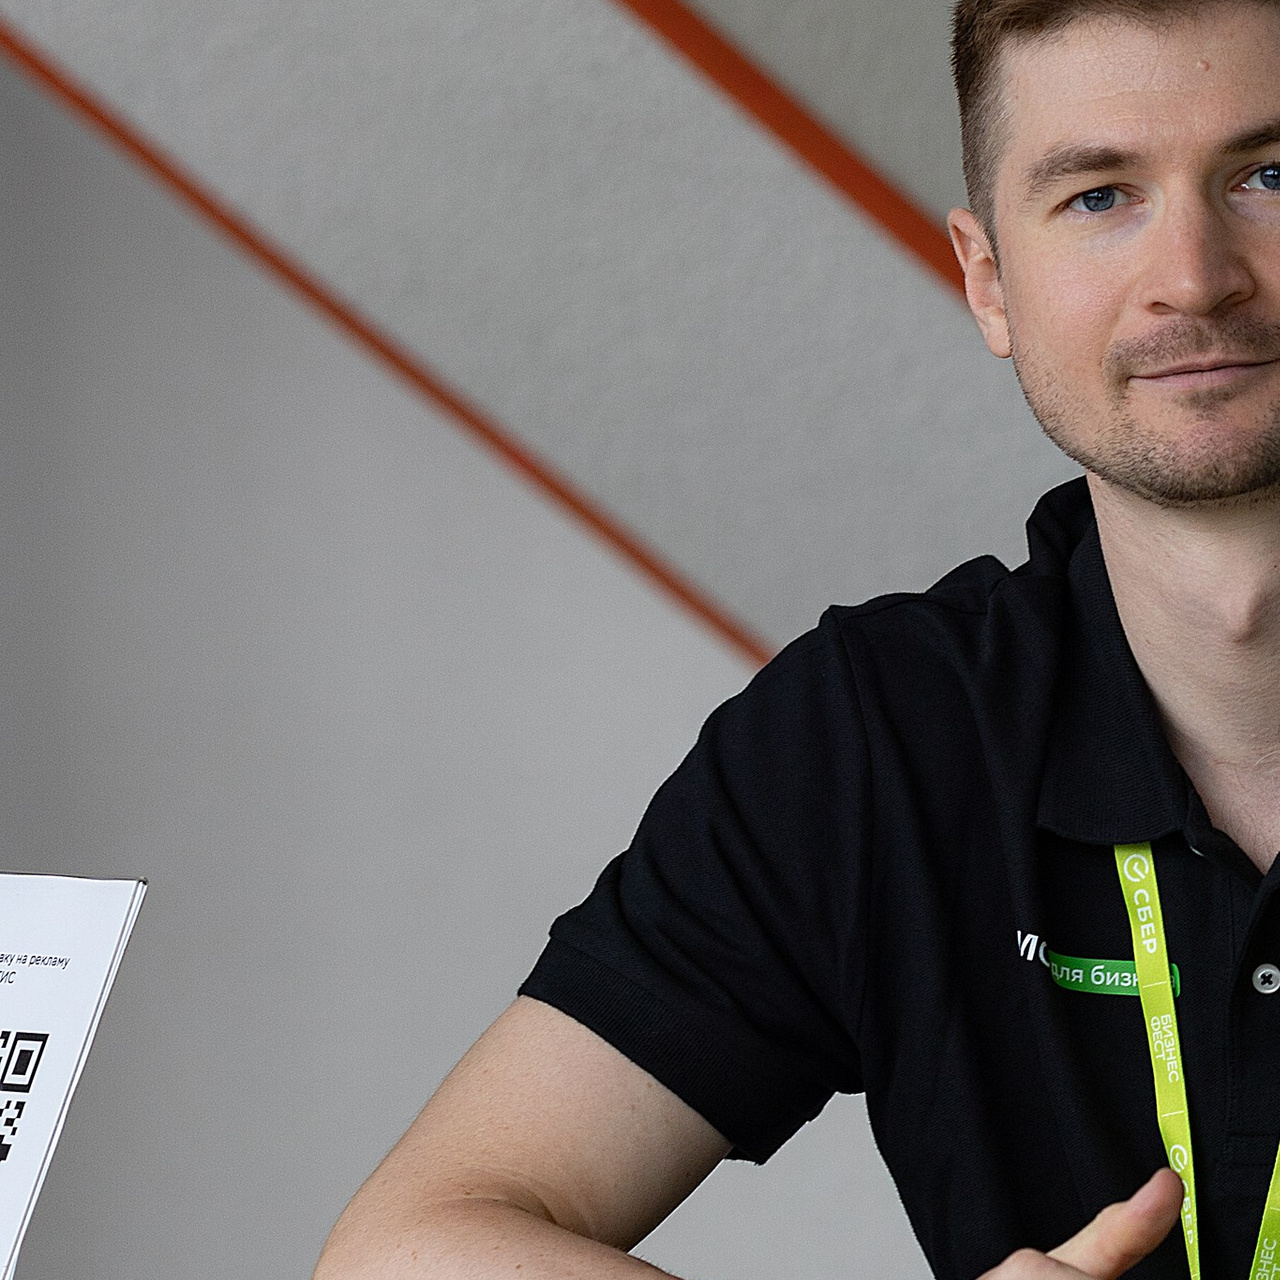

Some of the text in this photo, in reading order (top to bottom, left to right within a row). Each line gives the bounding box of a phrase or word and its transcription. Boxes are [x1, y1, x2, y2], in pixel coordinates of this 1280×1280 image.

[1134, 888, 1157, 954] СБЕР
[0, 970, 16, 984] ИС
[16, 954, 28, 964] на
[28, 955, 71, 970] рекламу
[1051, 962, 1084, 983] для
[1150, 1016, 1166, 1061] ФЕСТ
[1160, 1013, 1180, 1083] БИЗНЕС
